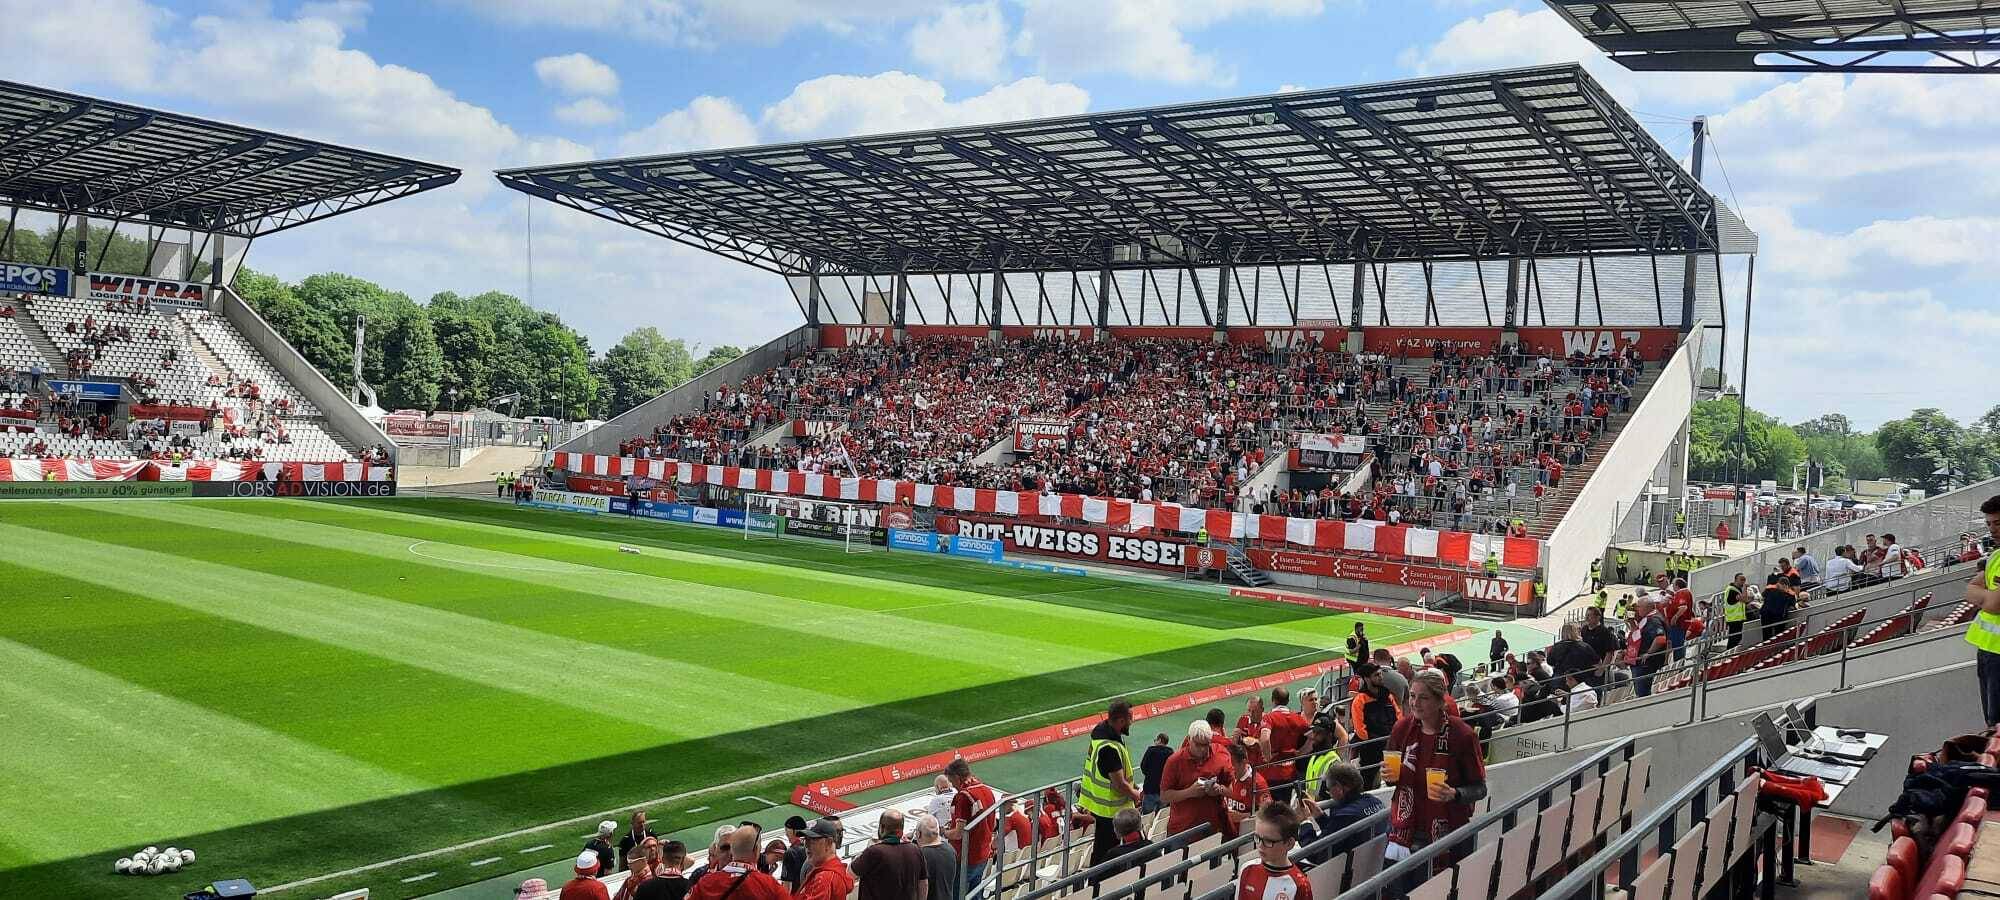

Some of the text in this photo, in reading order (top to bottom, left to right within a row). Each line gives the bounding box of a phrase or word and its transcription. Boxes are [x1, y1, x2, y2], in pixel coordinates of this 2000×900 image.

[90, 274, 203, 300] WITRA
[147, 297, 203, 308] MMOBILIEN
[1562, 330, 1641, 359] WAZ
[112, 485, 138, 496] 60%
[1465, 577, 1518, 603] WAZ
[1516, 737, 1549, 752] REIHE
